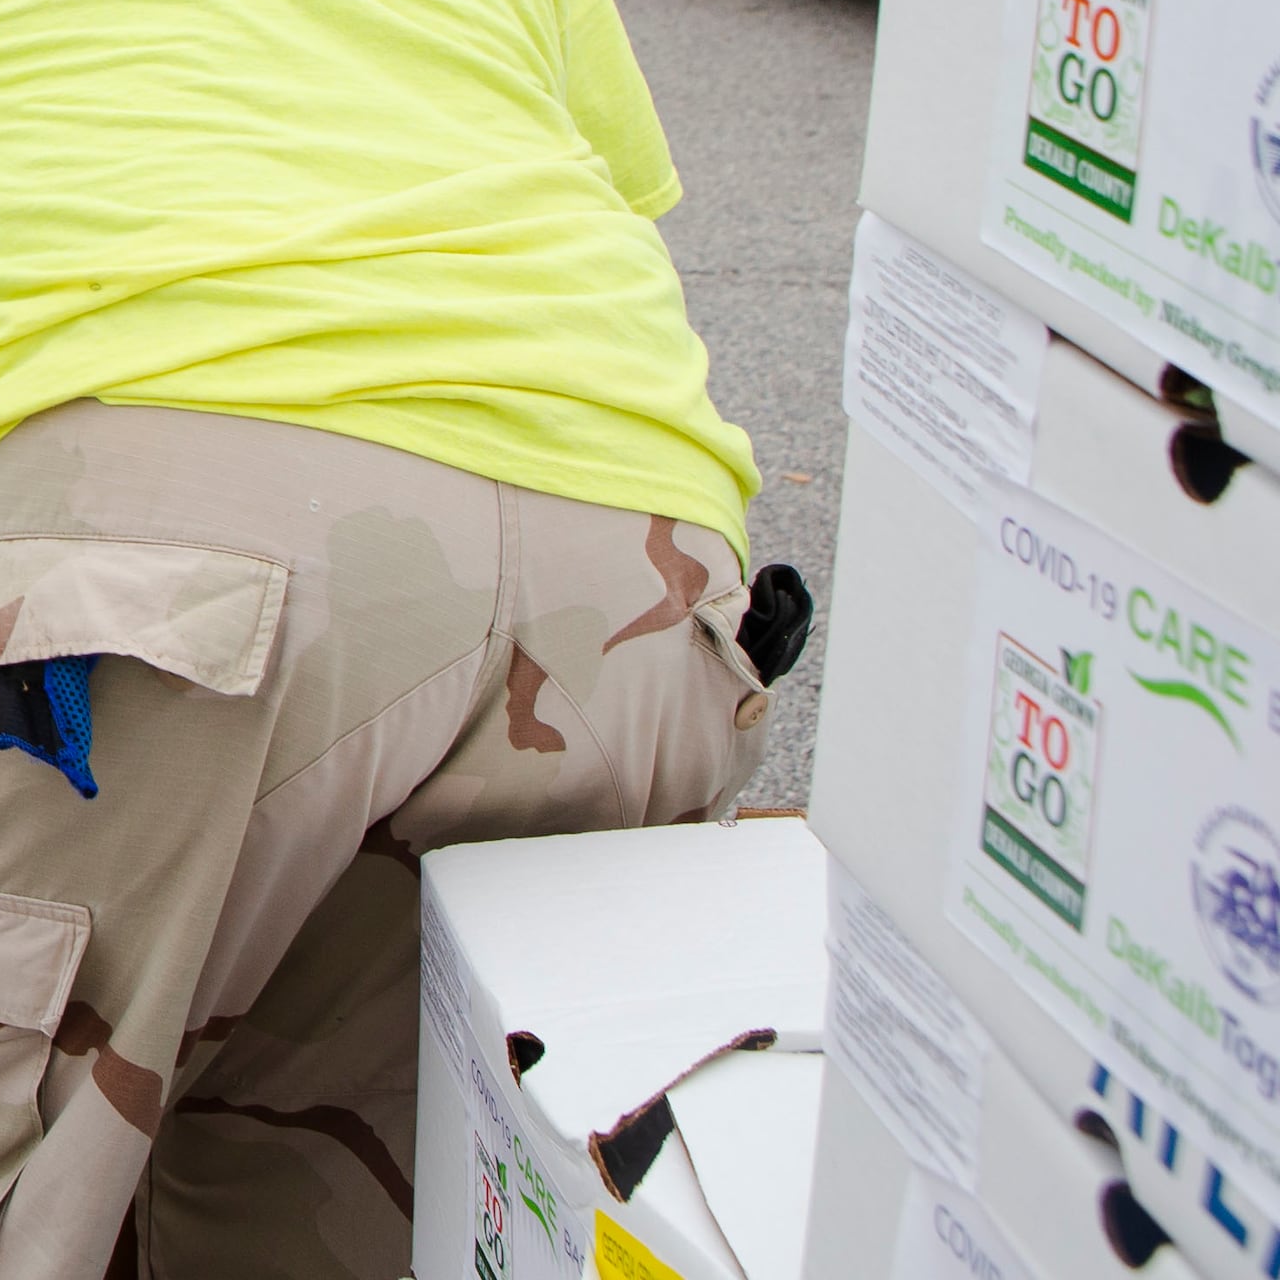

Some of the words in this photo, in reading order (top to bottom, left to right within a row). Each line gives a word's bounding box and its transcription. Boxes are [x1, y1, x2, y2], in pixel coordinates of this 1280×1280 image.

[1056, 51, 1119, 122] GO
[1000, 516, 1118, 622] COVID-19
[1126, 586, 1252, 709] CARE
[1013, 689, 1071, 771] TO
[1010, 750, 1068, 829] GO
[471, 1058, 512, 1151] COVID-19
[482, 1172, 503, 1234] TO
[513, 1134, 558, 1233] CARE
[483, 1210, 504, 1270] GO
